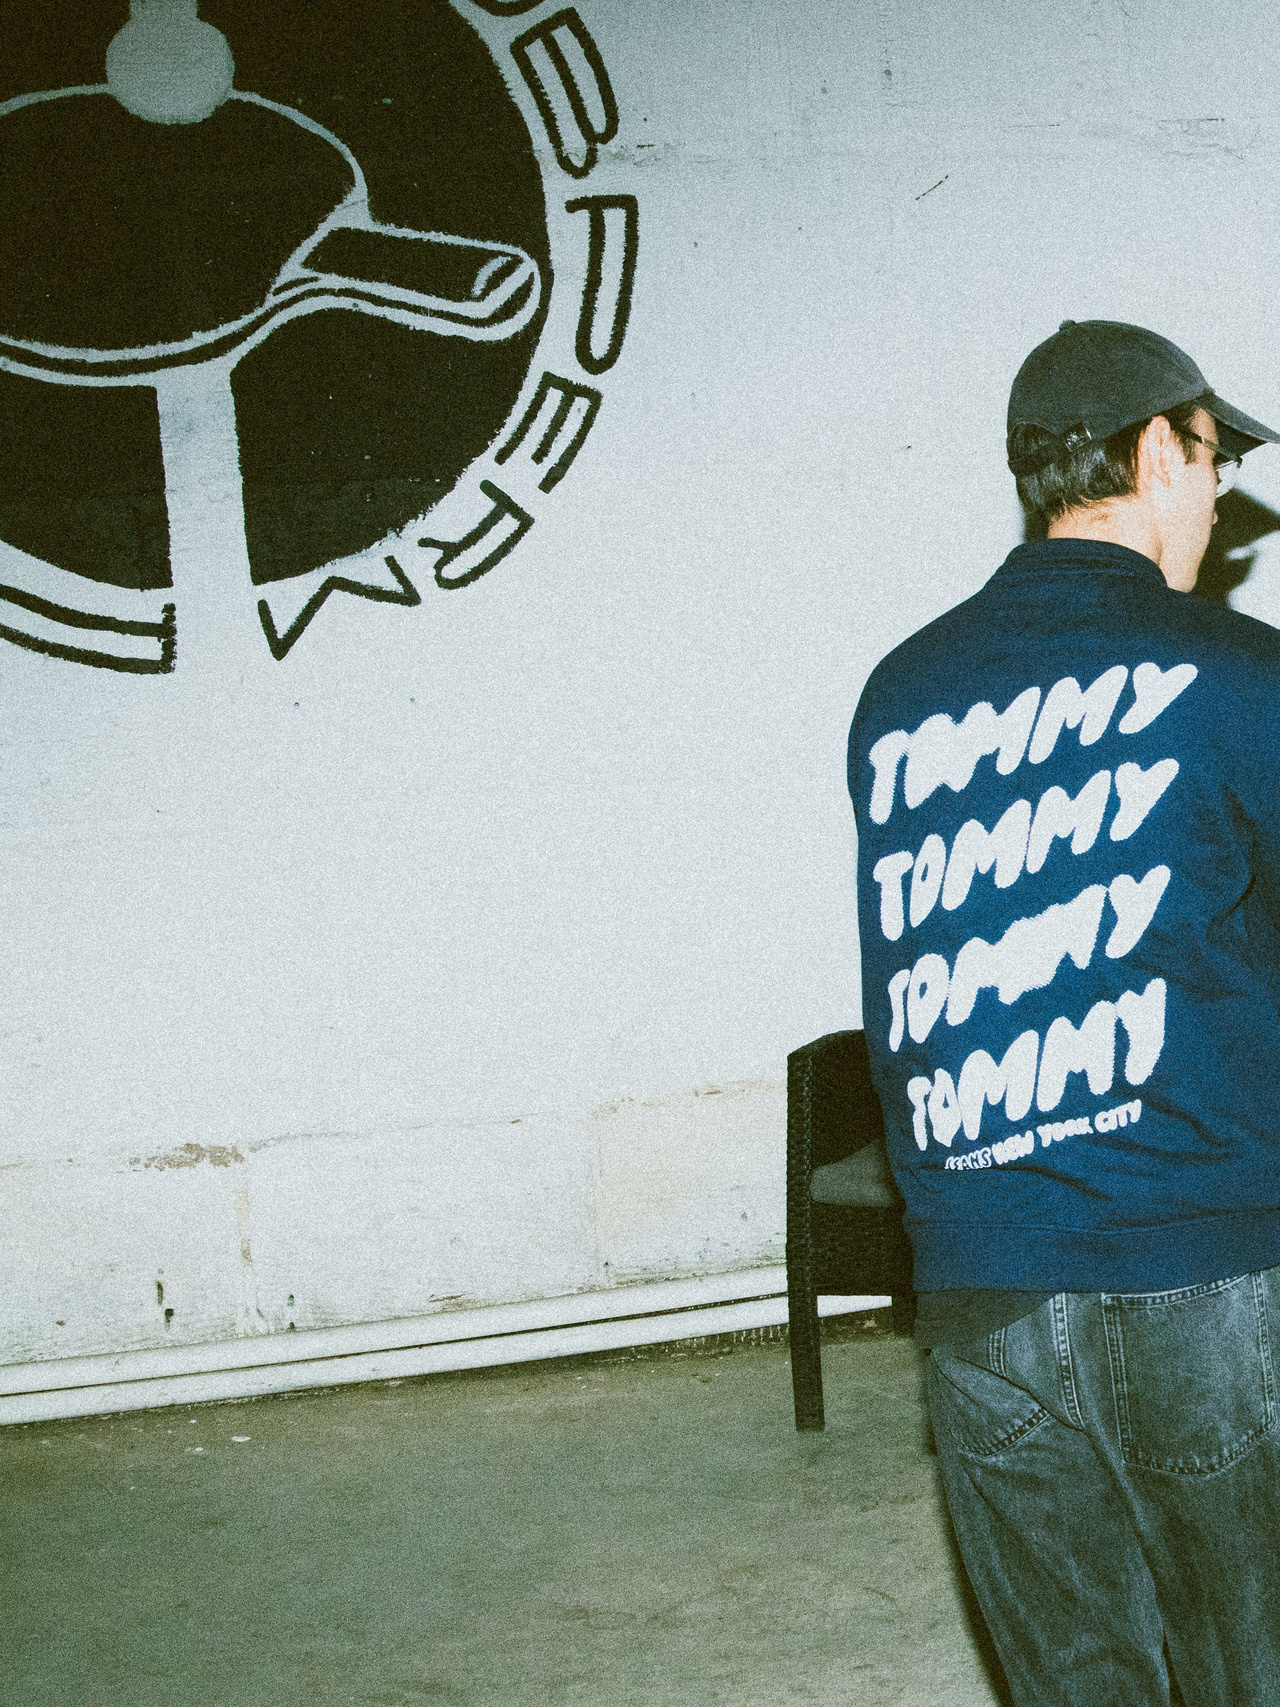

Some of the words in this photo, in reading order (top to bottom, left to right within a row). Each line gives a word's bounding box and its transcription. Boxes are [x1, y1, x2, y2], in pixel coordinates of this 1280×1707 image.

[868, 661, 1199, 825] TOMMY
[872, 758, 1180, 941] TOMMY
[887, 865, 1172, 1052] TOMMY
[907, 977, 1167, 1151] TOMMY
[991, 1130, 1034, 1165] NEW
[1036, 1116, 1093, 1148] YORK
[1094, 1099, 1142, 1133] CITY
